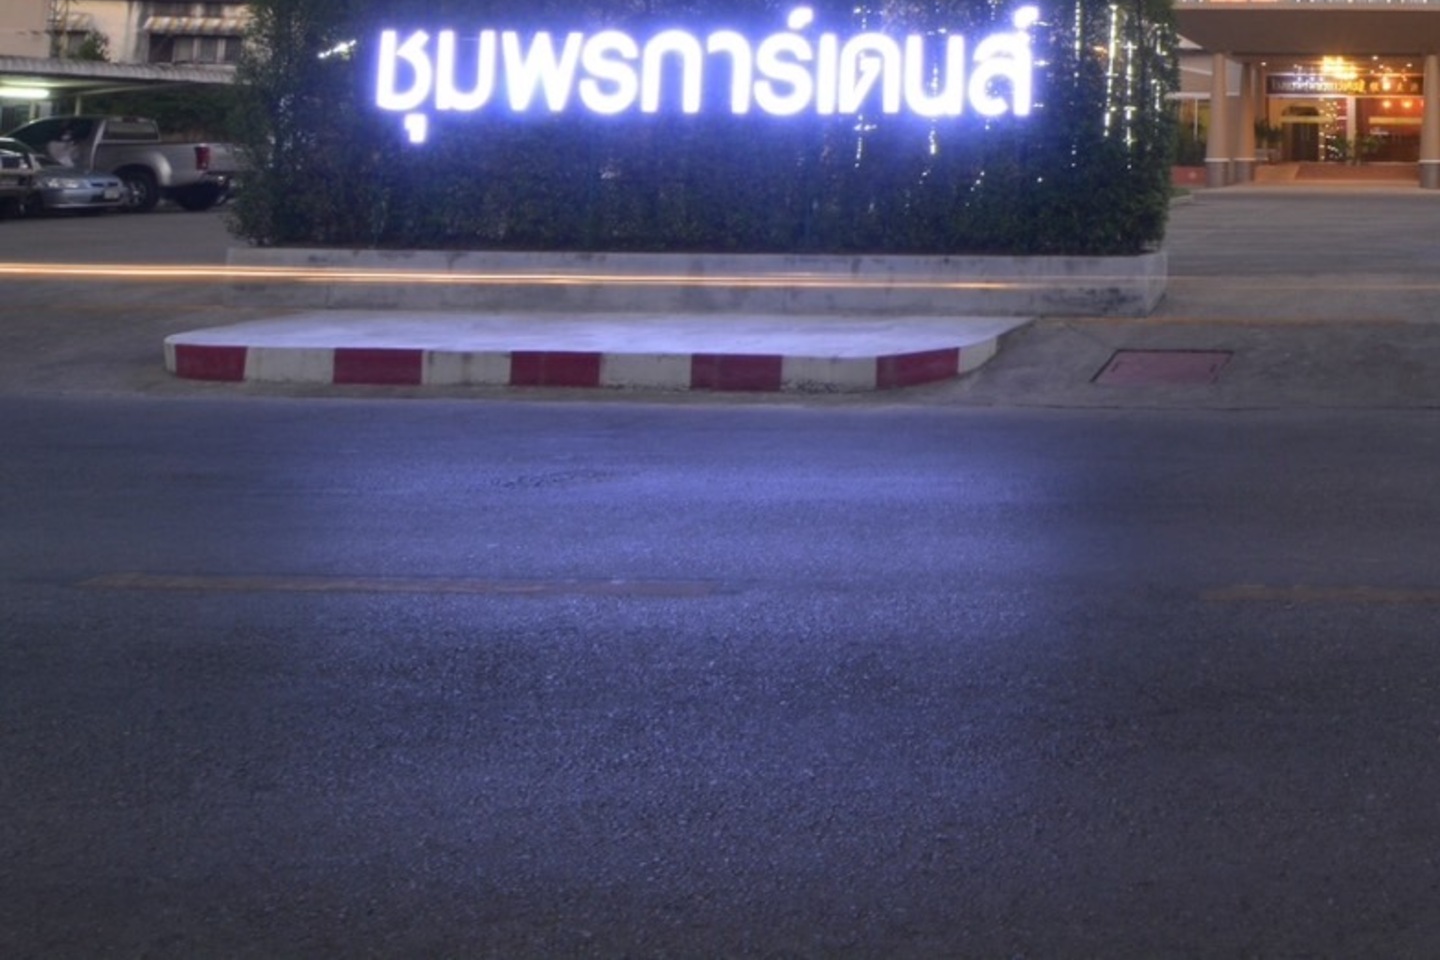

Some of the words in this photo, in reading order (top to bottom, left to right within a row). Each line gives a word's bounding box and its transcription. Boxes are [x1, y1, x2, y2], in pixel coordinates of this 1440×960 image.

[375, 6, 1039, 143] ชุมพรการ์เดนส์
